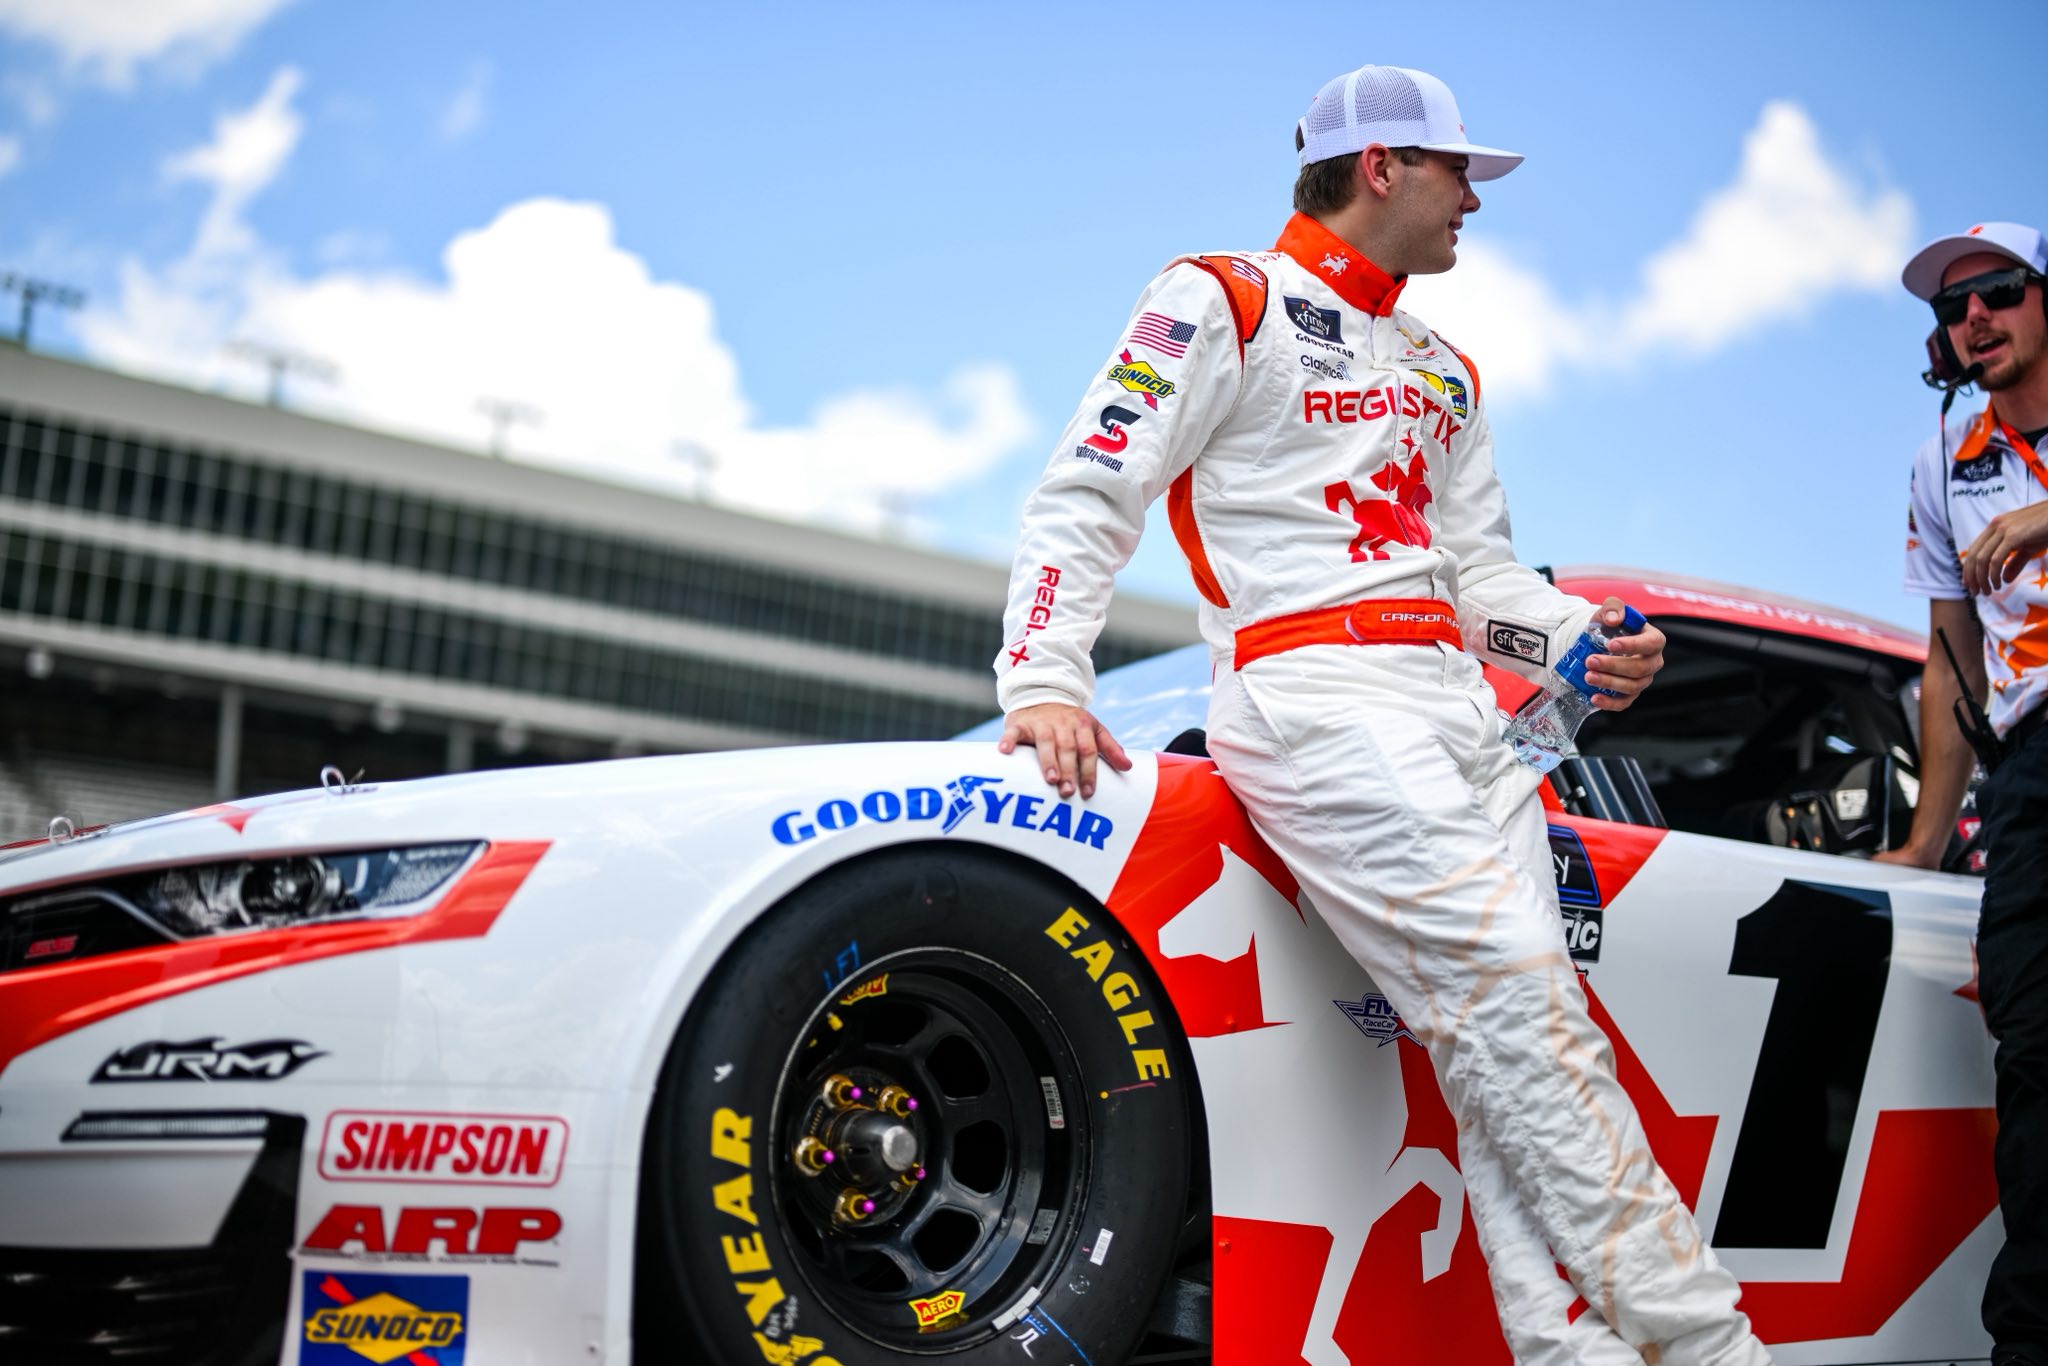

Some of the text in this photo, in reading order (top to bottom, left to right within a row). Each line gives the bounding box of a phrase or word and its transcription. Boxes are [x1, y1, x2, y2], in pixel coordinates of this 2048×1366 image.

[1295, 333, 1354, 360] GOODYEAR
[1110, 366, 1172, 396] SUNOCO
[1381, 613, 1446, 624] CARSON
[1497, 632, 1511, 647] sfi
[771, 776, 1114, 850] GOODYEAR
[1044, 906, 1171, 1081] EAGLE
[106, 1051, 294, 1084] JRM
[1711, 878, 1894, 1250] 1
[335, 1121, 549, 1176] SIMPSON
[302, 1204, 562, 1255] ARP
[921, 1295, 957, 1319] AERO
[312, 1312, 457, 1342] SUNOCO
